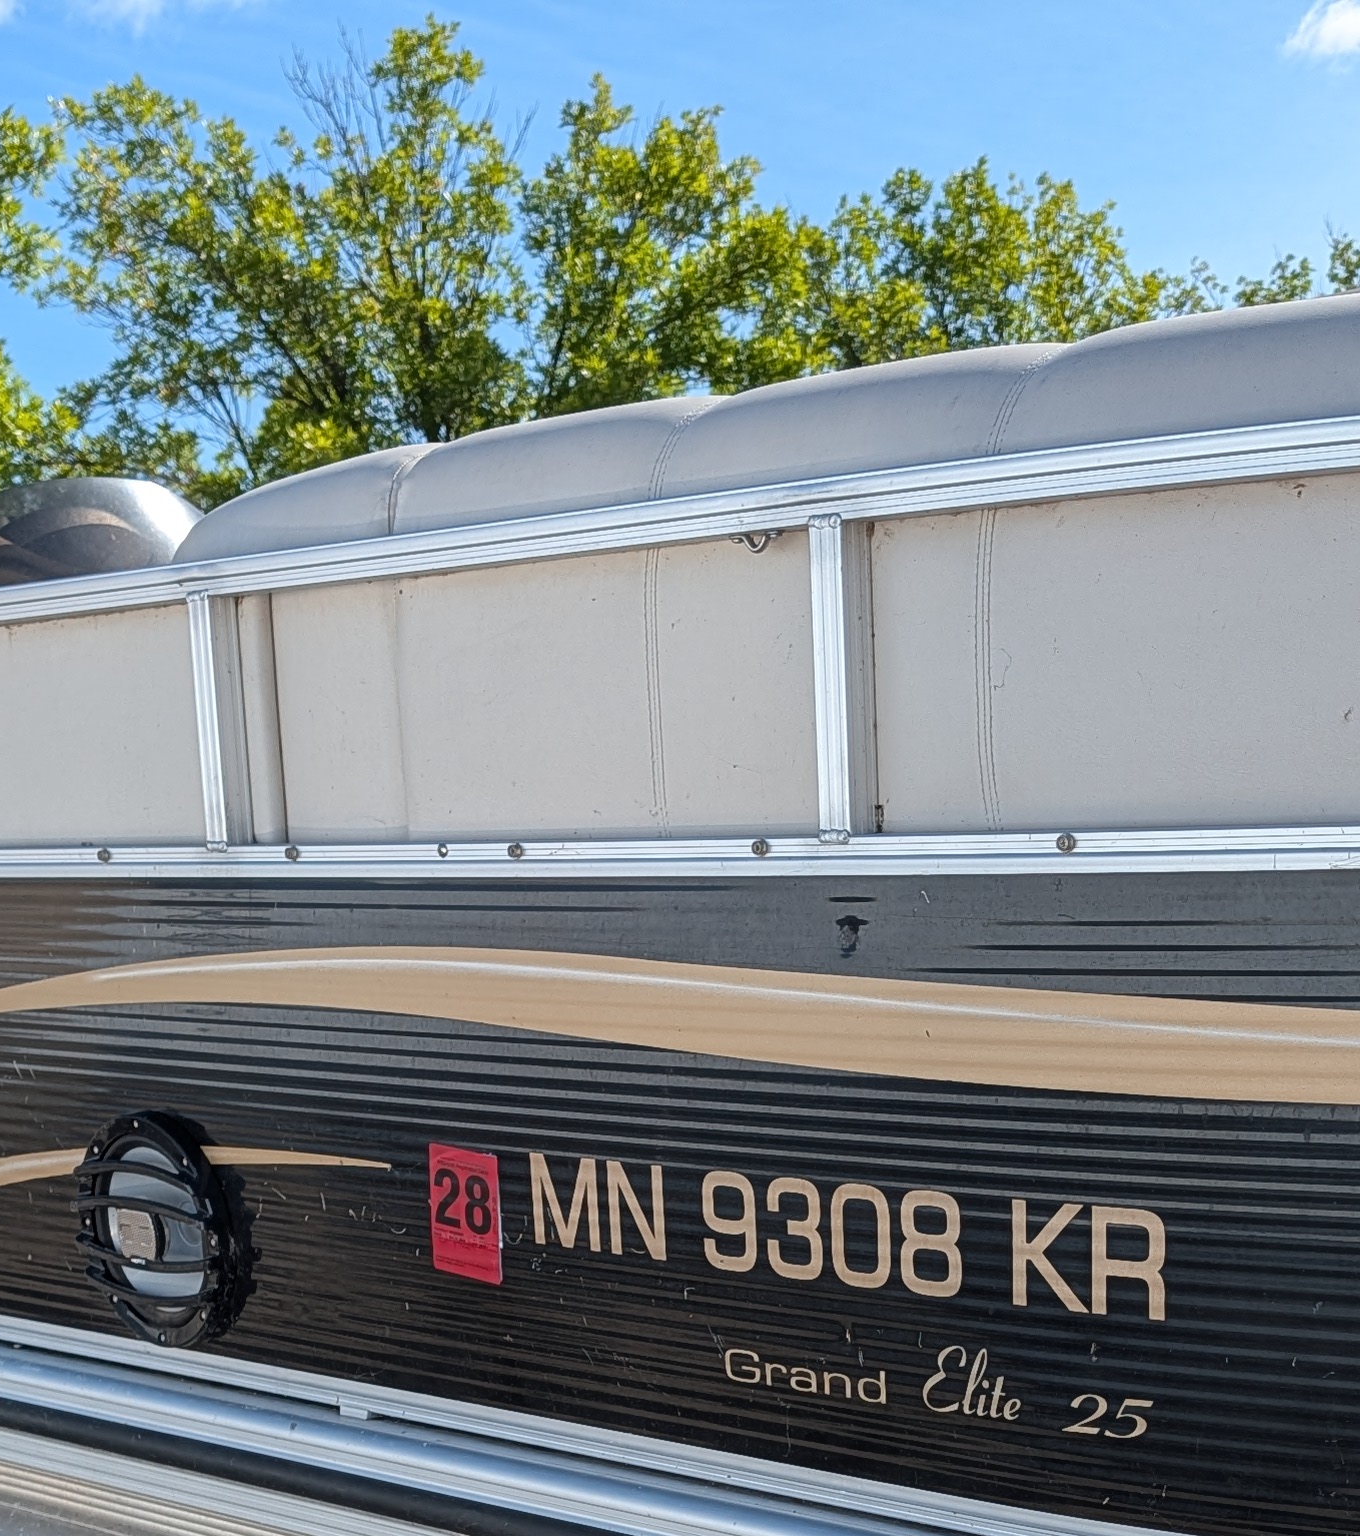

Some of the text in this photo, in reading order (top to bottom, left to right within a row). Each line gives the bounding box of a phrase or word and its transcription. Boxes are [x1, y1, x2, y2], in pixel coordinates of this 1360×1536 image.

[433, 1167, 491, 1236] 28
[529, 1152, 1165, 1320] MN 9308 KR
[723, 1345, 1155, 1439] Grand Elite 25
